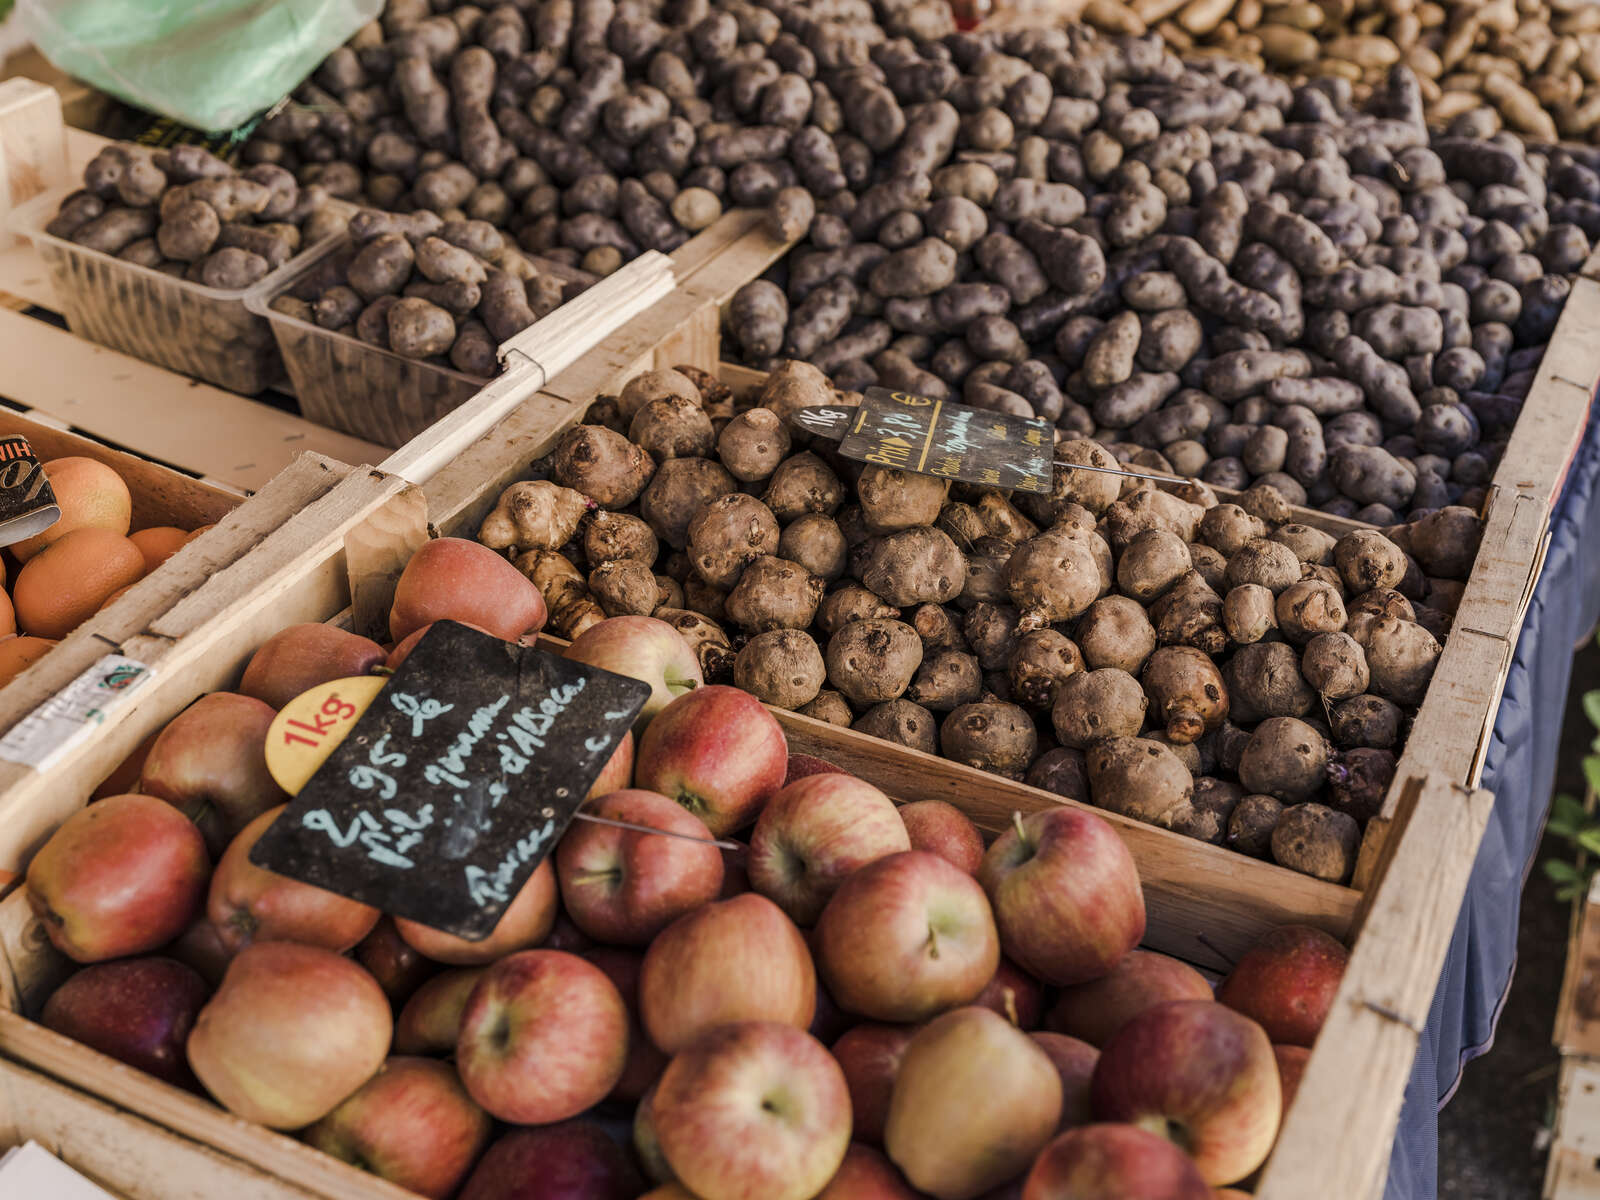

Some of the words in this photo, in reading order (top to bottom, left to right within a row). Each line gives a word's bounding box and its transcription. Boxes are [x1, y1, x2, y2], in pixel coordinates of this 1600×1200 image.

[800, 408, 848, 428] 1Kg
[864, 444, 912, 468] Prix
[284, 692, 356, 748] 1kg
